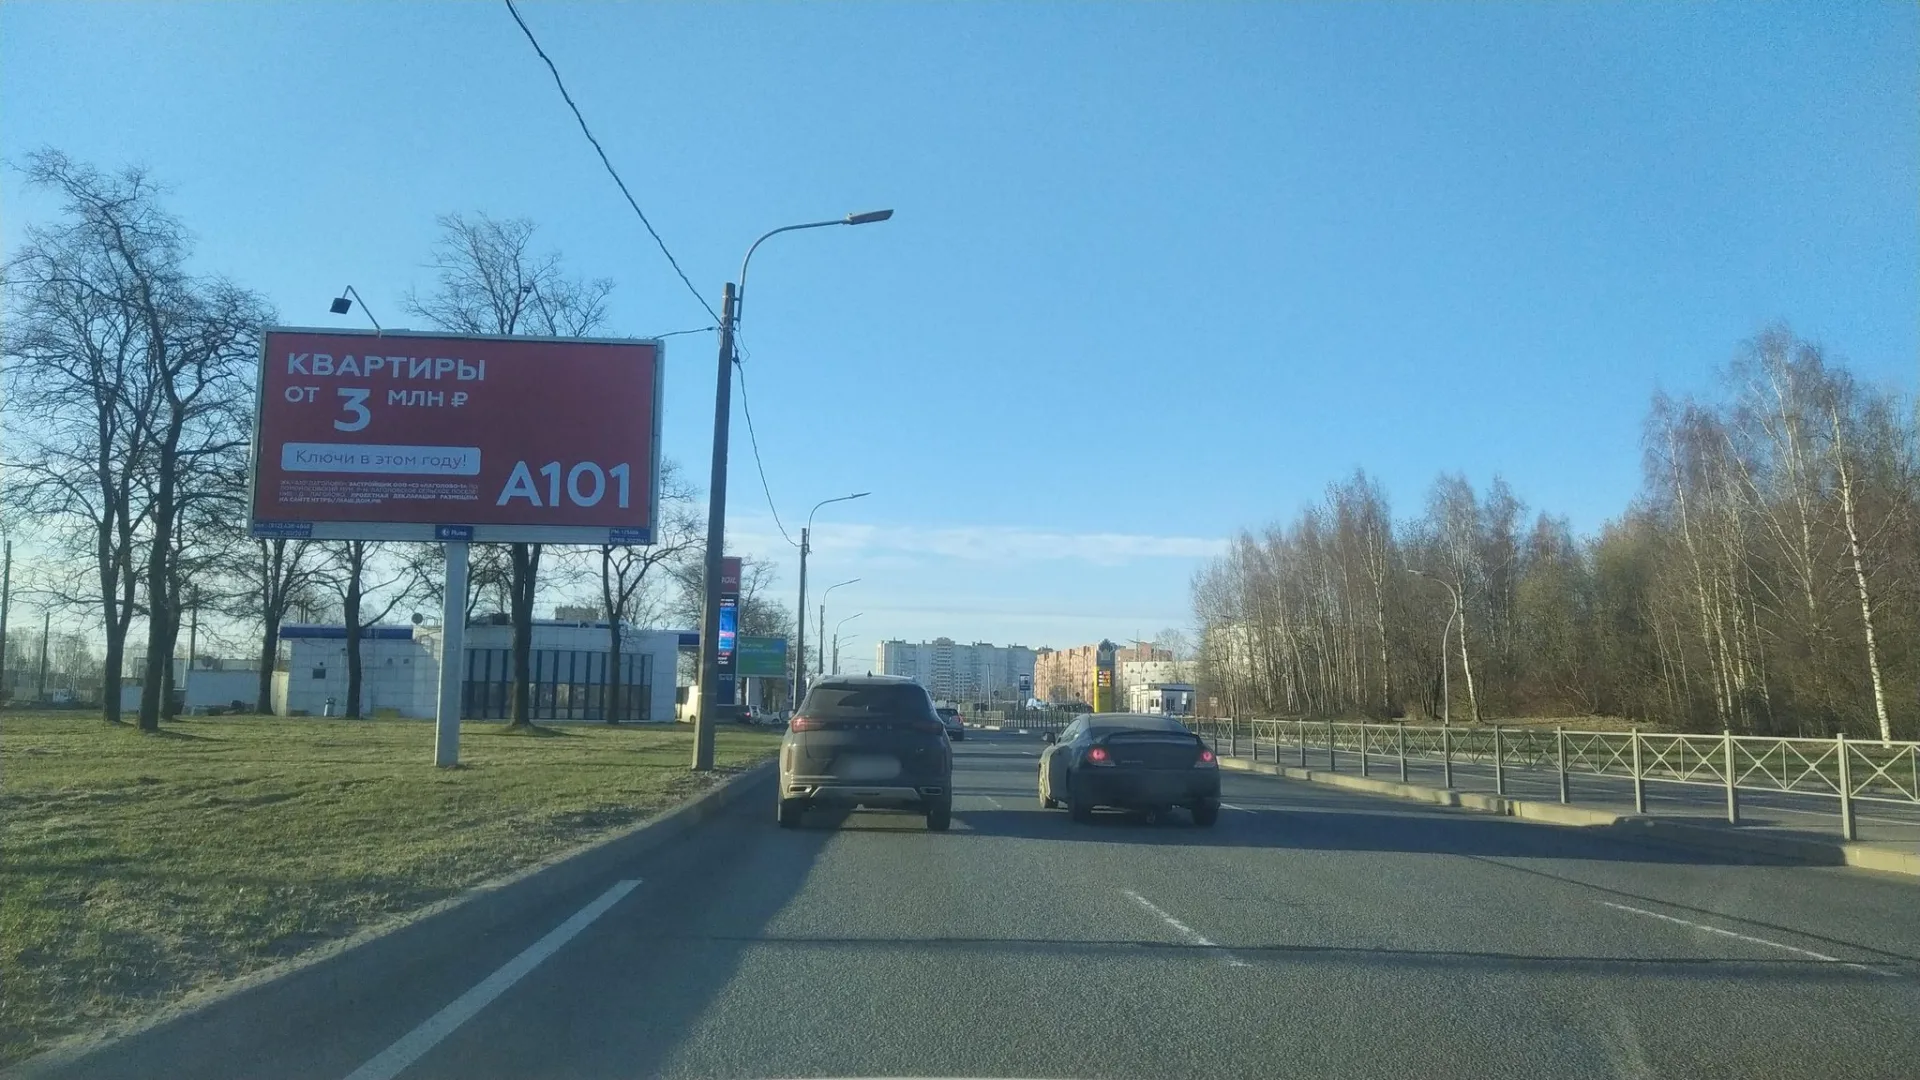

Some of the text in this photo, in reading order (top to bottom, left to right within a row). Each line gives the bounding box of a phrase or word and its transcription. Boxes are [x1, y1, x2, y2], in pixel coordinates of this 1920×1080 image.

[287, 352, 486, 381] КВАРТИРЫ
[284, 386, 320, 403] ОТ
[333, 387, 372, 432] 3
[388, 389, 444, 407] МЛН
[296, 450, 467, 469] Ключи в этом году!
